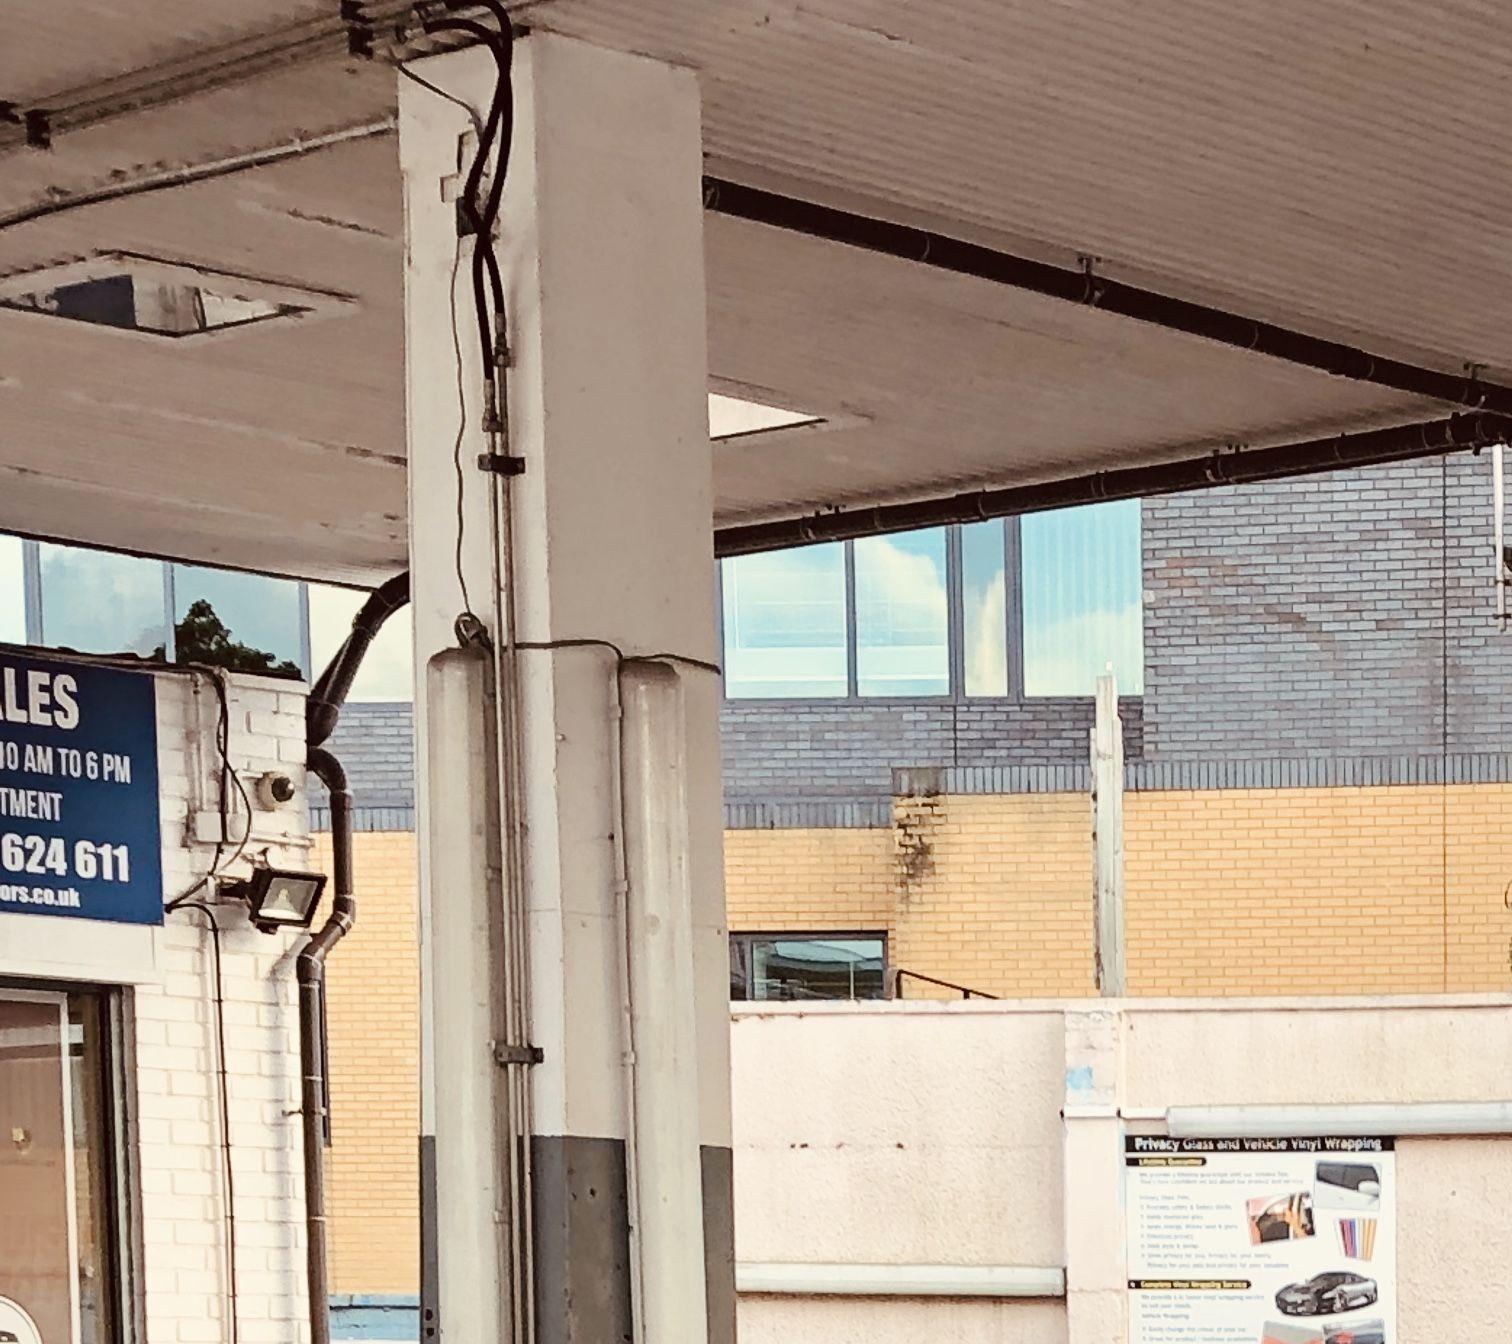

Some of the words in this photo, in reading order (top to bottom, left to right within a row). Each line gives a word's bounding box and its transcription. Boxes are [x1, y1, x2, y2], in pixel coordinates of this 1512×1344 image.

[0, 666, 79, 730] LES
[24, 744, 54, 776] AM
[57, 747, 82, 778] TO
[85, 751, 98, 780] 6
[103, 753, 132, 784] PM
[1, 833, 68, 876] 624
[75, 840, 130, 883] 611
[1135, 1138, 1179, 1152] Privacy
[1183, 1139, 1214, 1151] Glass
[1217, 1139, 1240, 1150] and
[1243, 1138, 1289, 1150] Vehicle
[1292, 1138, 1321, 1152] Vinyl
[1325, 1138, 1382, 1152] Wrapping
